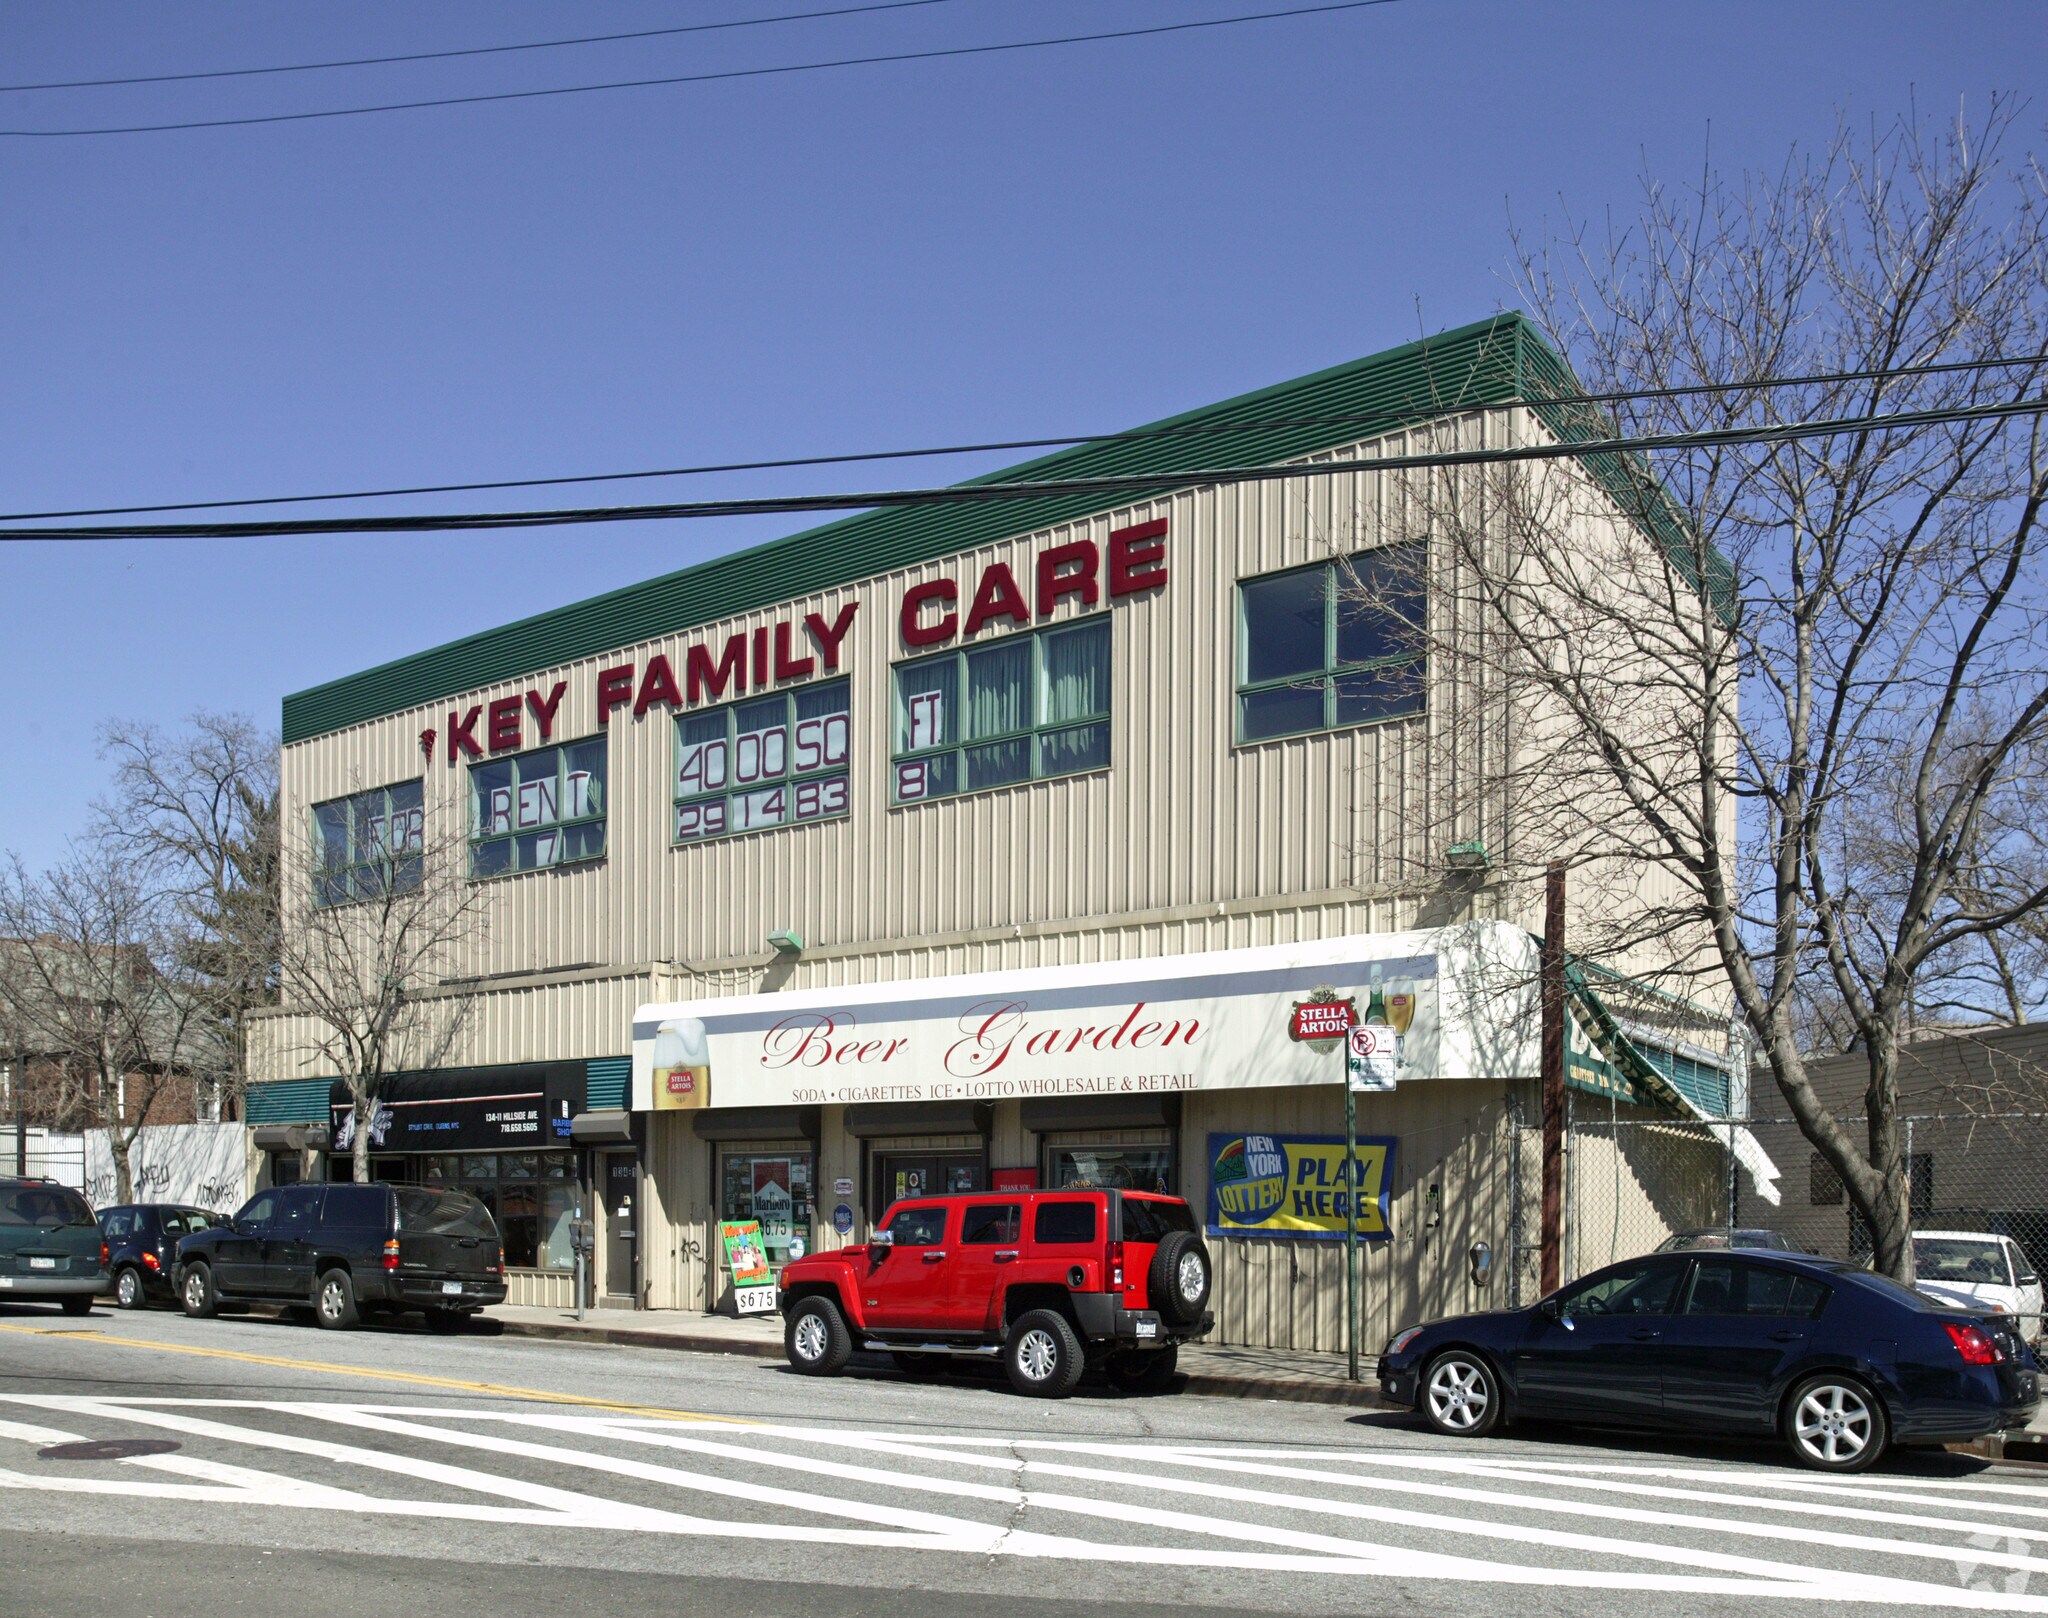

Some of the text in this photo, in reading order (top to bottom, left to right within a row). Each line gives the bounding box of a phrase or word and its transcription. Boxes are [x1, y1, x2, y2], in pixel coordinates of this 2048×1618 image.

[449, 517, 1169, 761] KEY FAMILY CARE
[492, 772, 589, 833] RENT
[679, 727, 787, 792] 4000
[795, 713, 850, 772] SQ
[1300, 1006, 1349, 1021] STELLA
[1299, 1019, 1349, 1034] ARTOIS
[760, 1000, 1212, 1078] Beer Garden
[670, 1075, 691, 1083] STELLA
[671, 1082, 692, 1090] ARTOIS
[792, 1073, 1199, 1103] SODA CIGARETTES ICE LOTTO WHOLESALE & RETAIL
[502, 1111, 526, 1121] HILLSIDE
[1246, 1135, 1275, 1153] NEW
[1247, 1154, 1283, 1178] YORK
[1296, 1157, 1374, 1188] PLAY
[754, 1191, 790, 1211] Marlboro
[1216, 1175, 1285, 1214] LOTTERY
[1292, 1189, 1371, 1219] HERE
